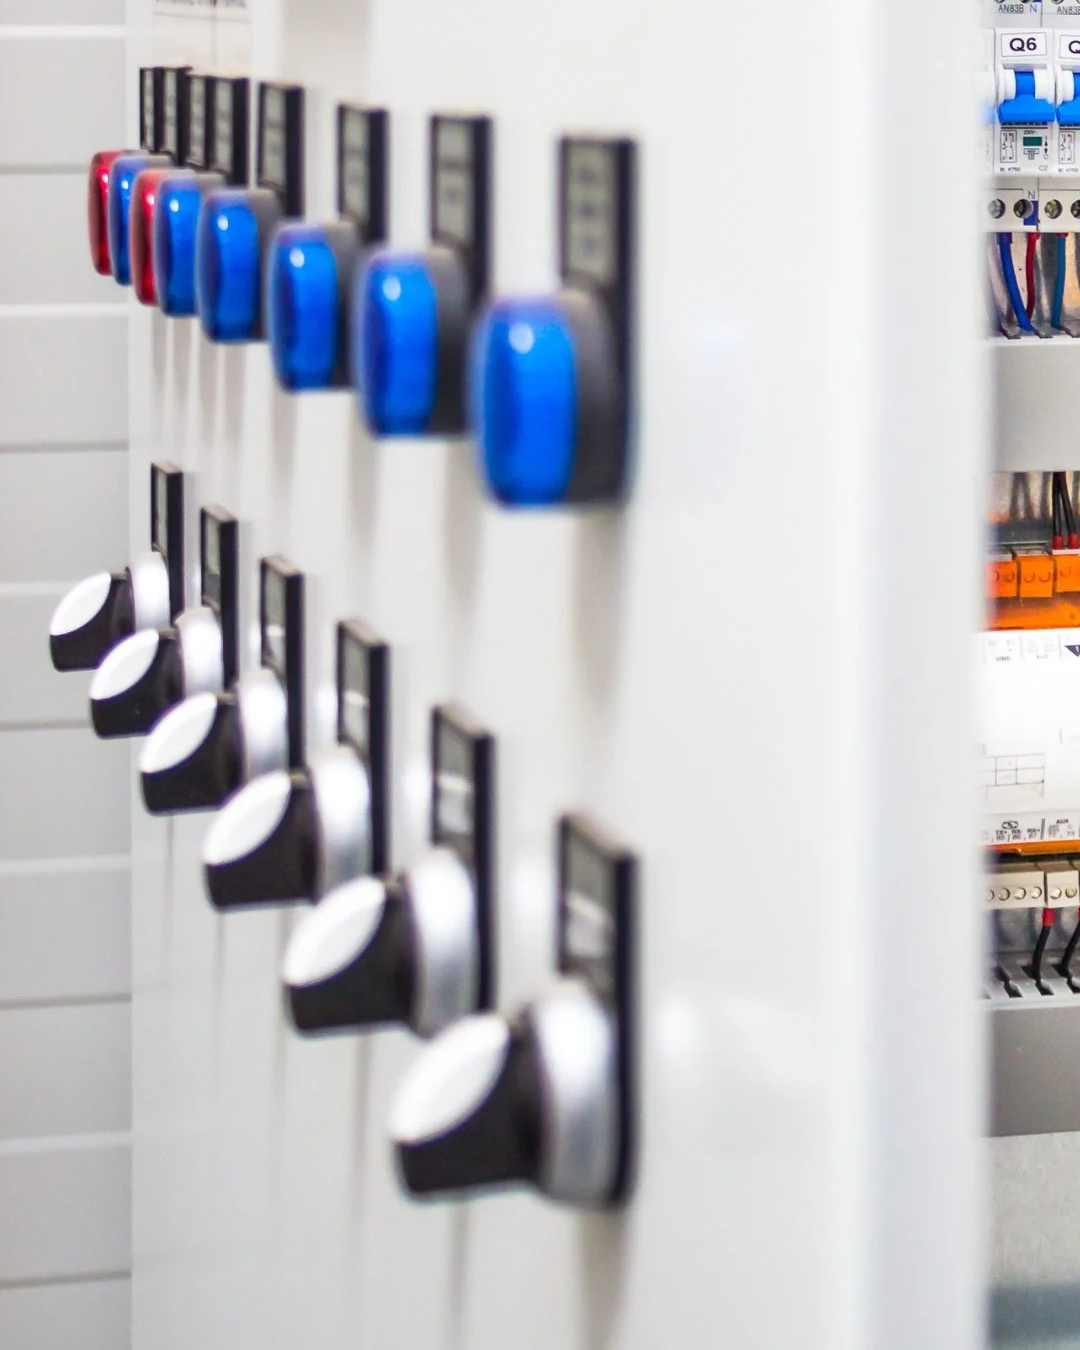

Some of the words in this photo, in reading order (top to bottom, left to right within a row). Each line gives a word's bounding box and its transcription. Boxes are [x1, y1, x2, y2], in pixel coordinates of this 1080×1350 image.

[1029, 3, 1038, 13] N
[1009, 37, 1037, 52] Q6
[1027, 190, 1036, 200] N
